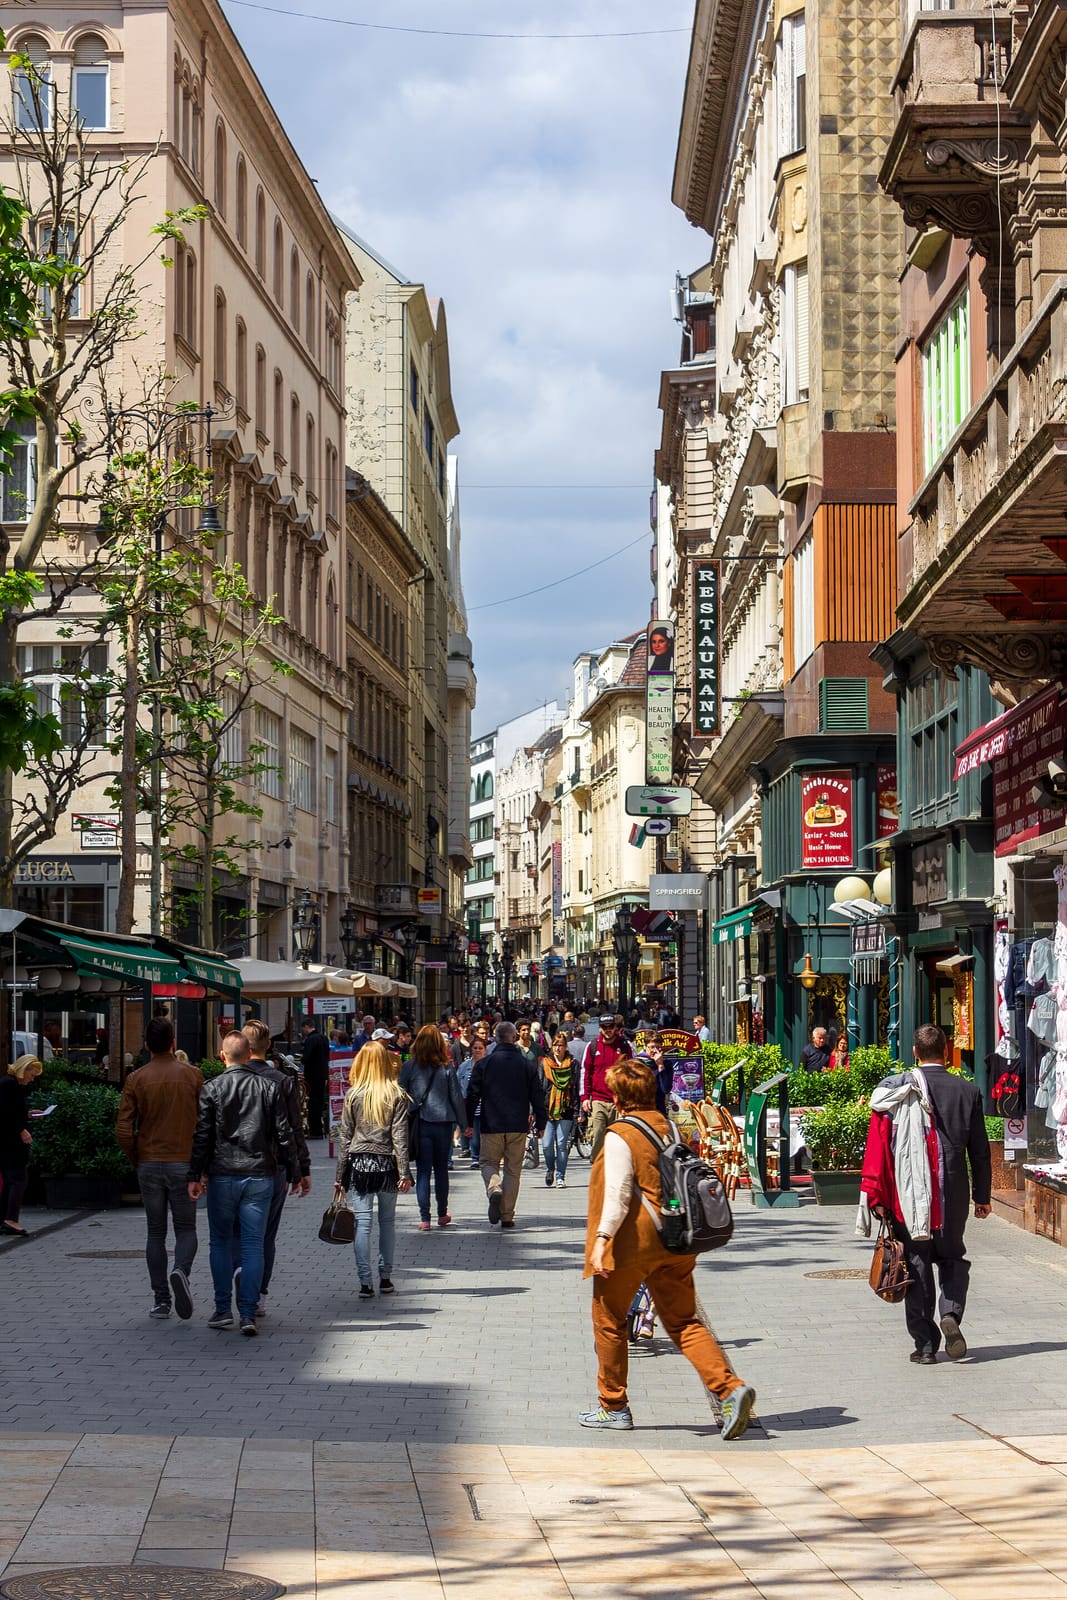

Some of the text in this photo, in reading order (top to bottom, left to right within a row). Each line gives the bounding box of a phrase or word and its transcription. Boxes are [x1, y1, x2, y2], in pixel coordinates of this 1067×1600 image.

[697, 570, 716, 728] RESTAURANT
[803, 856, 817, 864] OPEN
[824, 855, 850, 863] HOURS
[15, 861, 73, 877] LUCIA
[655, 888, 702, 897] SPRINGFIELD
[661, 1032, 690, 1042] ungary
[673, 1040, 688, 1049] Art
